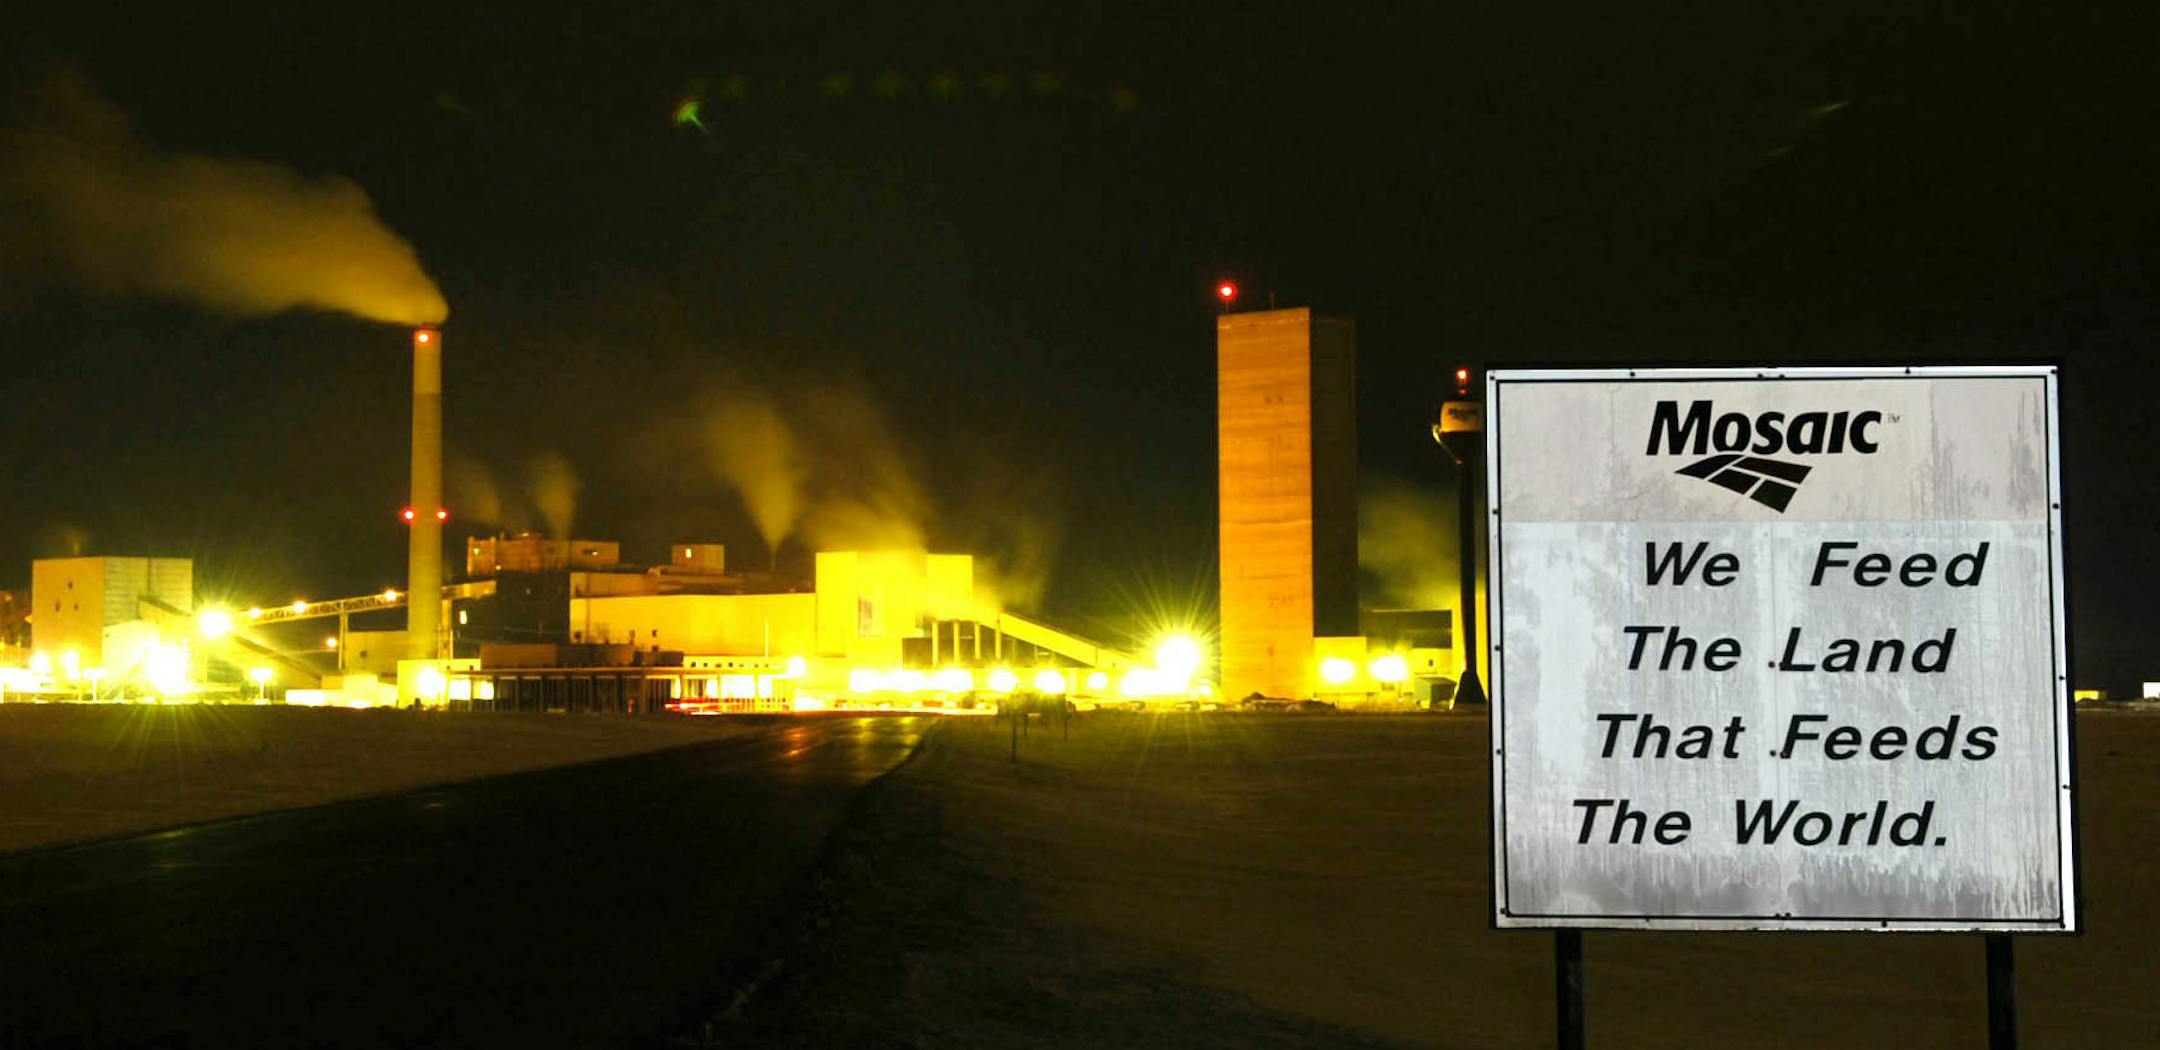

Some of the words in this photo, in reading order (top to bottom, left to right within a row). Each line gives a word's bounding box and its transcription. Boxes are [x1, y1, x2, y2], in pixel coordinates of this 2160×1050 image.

[1646, 400, 1882, 455] Mosaic
[1646, 542, 1740, 587] We
[1811, 542, 1990, 588] Feed
[1624, 626, 1742, 672] The
[1779, 627, 1957, 673] Land
[1597, 714, 1746, 760] That
[1780, 715, 1999, 761] Feeds
[1573, 799, 1692, 846] The
[1736, 800, 1947, 847] World.
